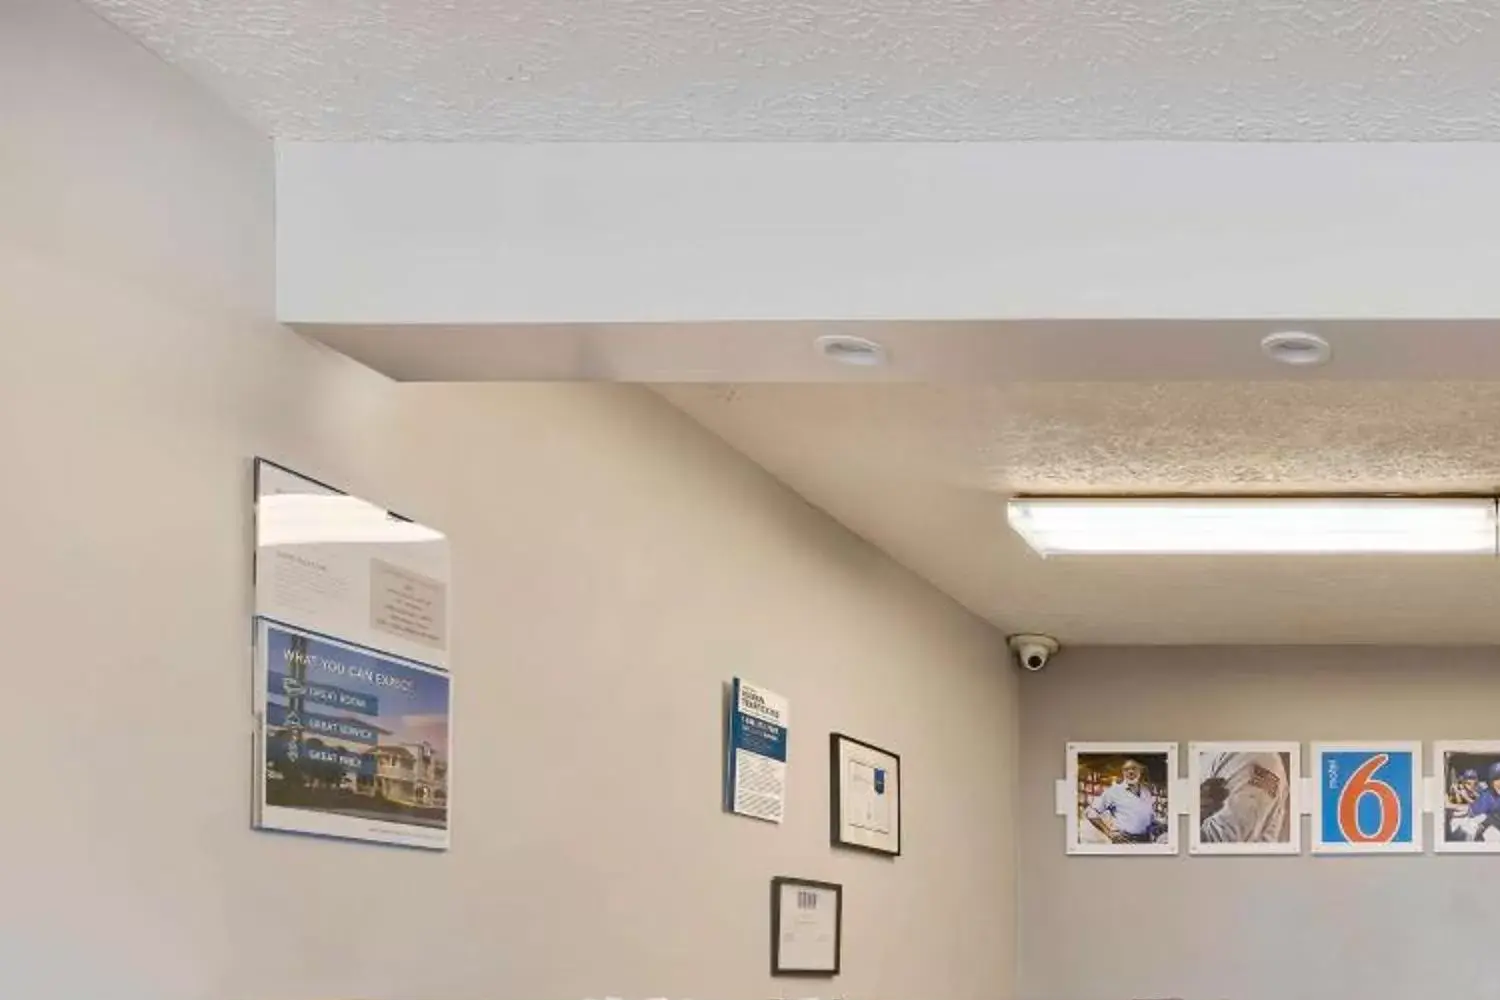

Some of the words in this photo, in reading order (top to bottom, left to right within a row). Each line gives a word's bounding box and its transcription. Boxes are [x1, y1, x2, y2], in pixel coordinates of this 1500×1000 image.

[284, 648, 316, 666] WHAT
[322, 657, 345, 674] YOU
[349, 665, 373, 684] CAN
[1337, 754, 1400, 844] 6
